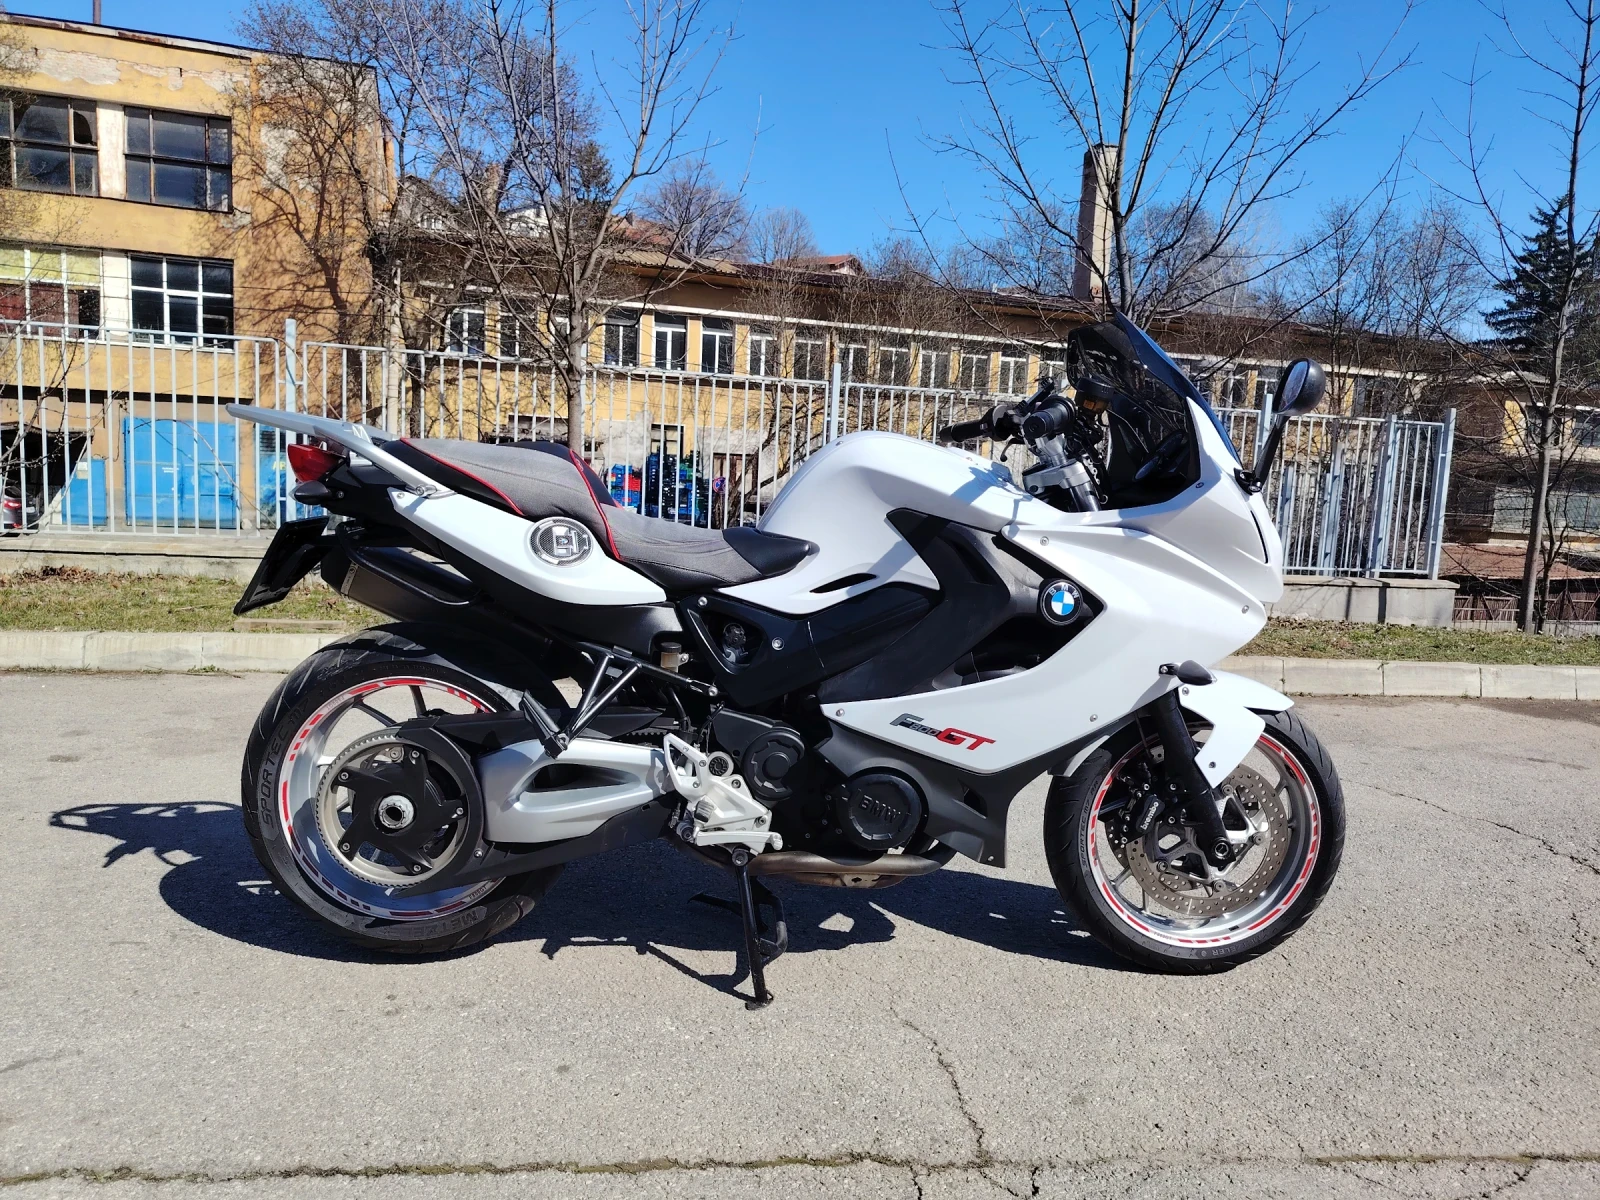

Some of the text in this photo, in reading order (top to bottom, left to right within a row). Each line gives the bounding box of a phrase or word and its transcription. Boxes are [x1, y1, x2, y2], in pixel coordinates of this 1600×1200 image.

[1048, 584, 1079, 599] BMW
[260, 725, 289, 829] SPORTEC
[861, 794, 902, 823] BMW
[1140, 801, 1159, 830] brembo
[1079, 816, 1088, 868] SPORTEC
